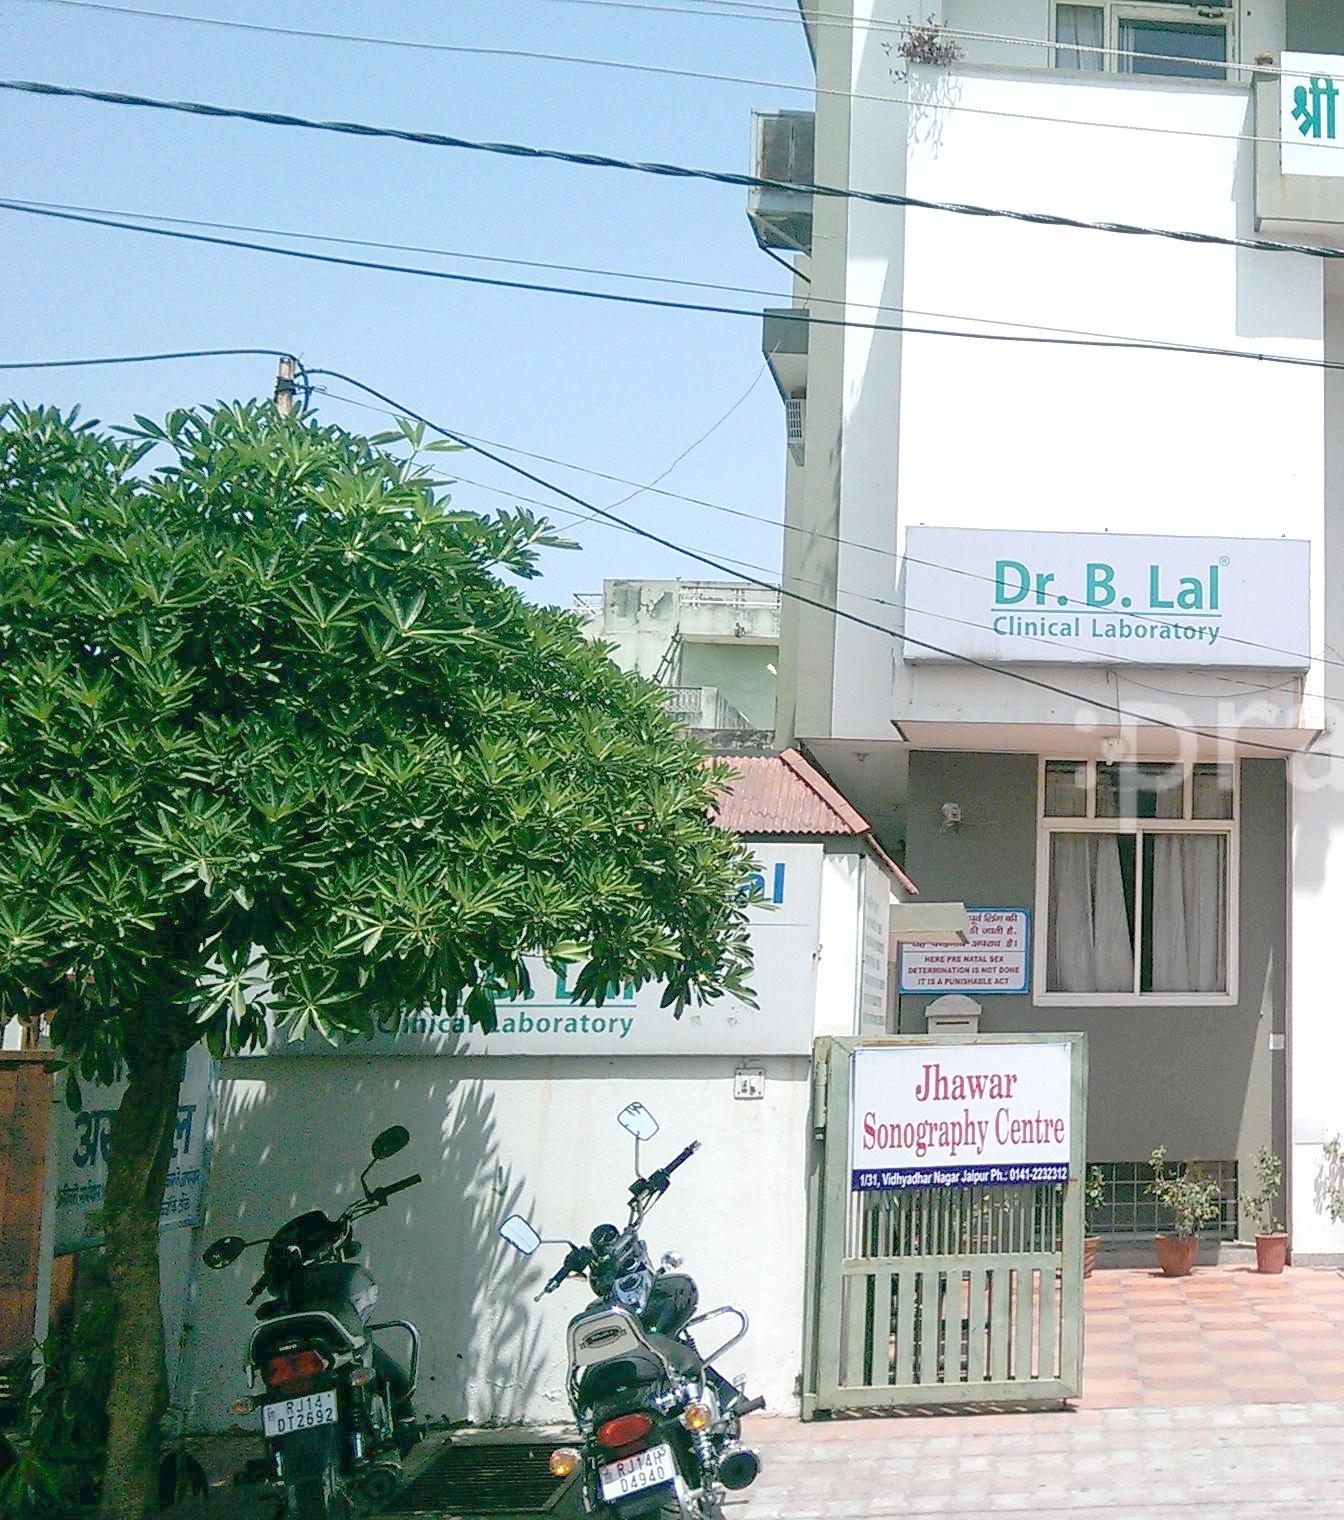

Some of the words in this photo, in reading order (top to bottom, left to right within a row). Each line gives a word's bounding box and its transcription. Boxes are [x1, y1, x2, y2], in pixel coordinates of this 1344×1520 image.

[1291, 72, 1339, 140] श्री
[995, 559, 1068, 606] Dr.
[1086, 562, 1132, 608] B.
[993, 615, 1080, 637] Clinical
[1092, 618, 1220, 645] Laboratory
[908, 966, 969, 974] DETERMINATION
[972, 966, 979, 974] IS
[981, 966, 997, 974] NOT
[999, 966, 1020, 974] DONE
[947, 955, 961, 963] PRE
[963, 955, 987, 963] NATAL
[990, 955, 1004, 963] SEX
[918, 977, 926, 985] IT
[928, 977, 935, 985] IS
[937, 977, 943, 985] A
[945, 977, 993, 985] PUNISHABLE
[994, 977, 1010, 985] ACT
[915, 1063, 1018, 1103] Jhawar
[863, 1107, 989, 1157] Sonography
[995, 1107, 1065, 1146] Centre
[859, 1174, 880, 1188] 1/31,
[882, 1171, 933, 1188] Vidhyadhar
[934, 1171, 959, 1186] Nagar
[960, 1170, 988, 1185] Jaipur
[1009, 1166, 1067, 1181] 0141-2232312
[287, 1395, 322, 1414] RJ14
[278, 1408, 333, 1432] DT2692
[621, 1466, 664, 1493] D4940
